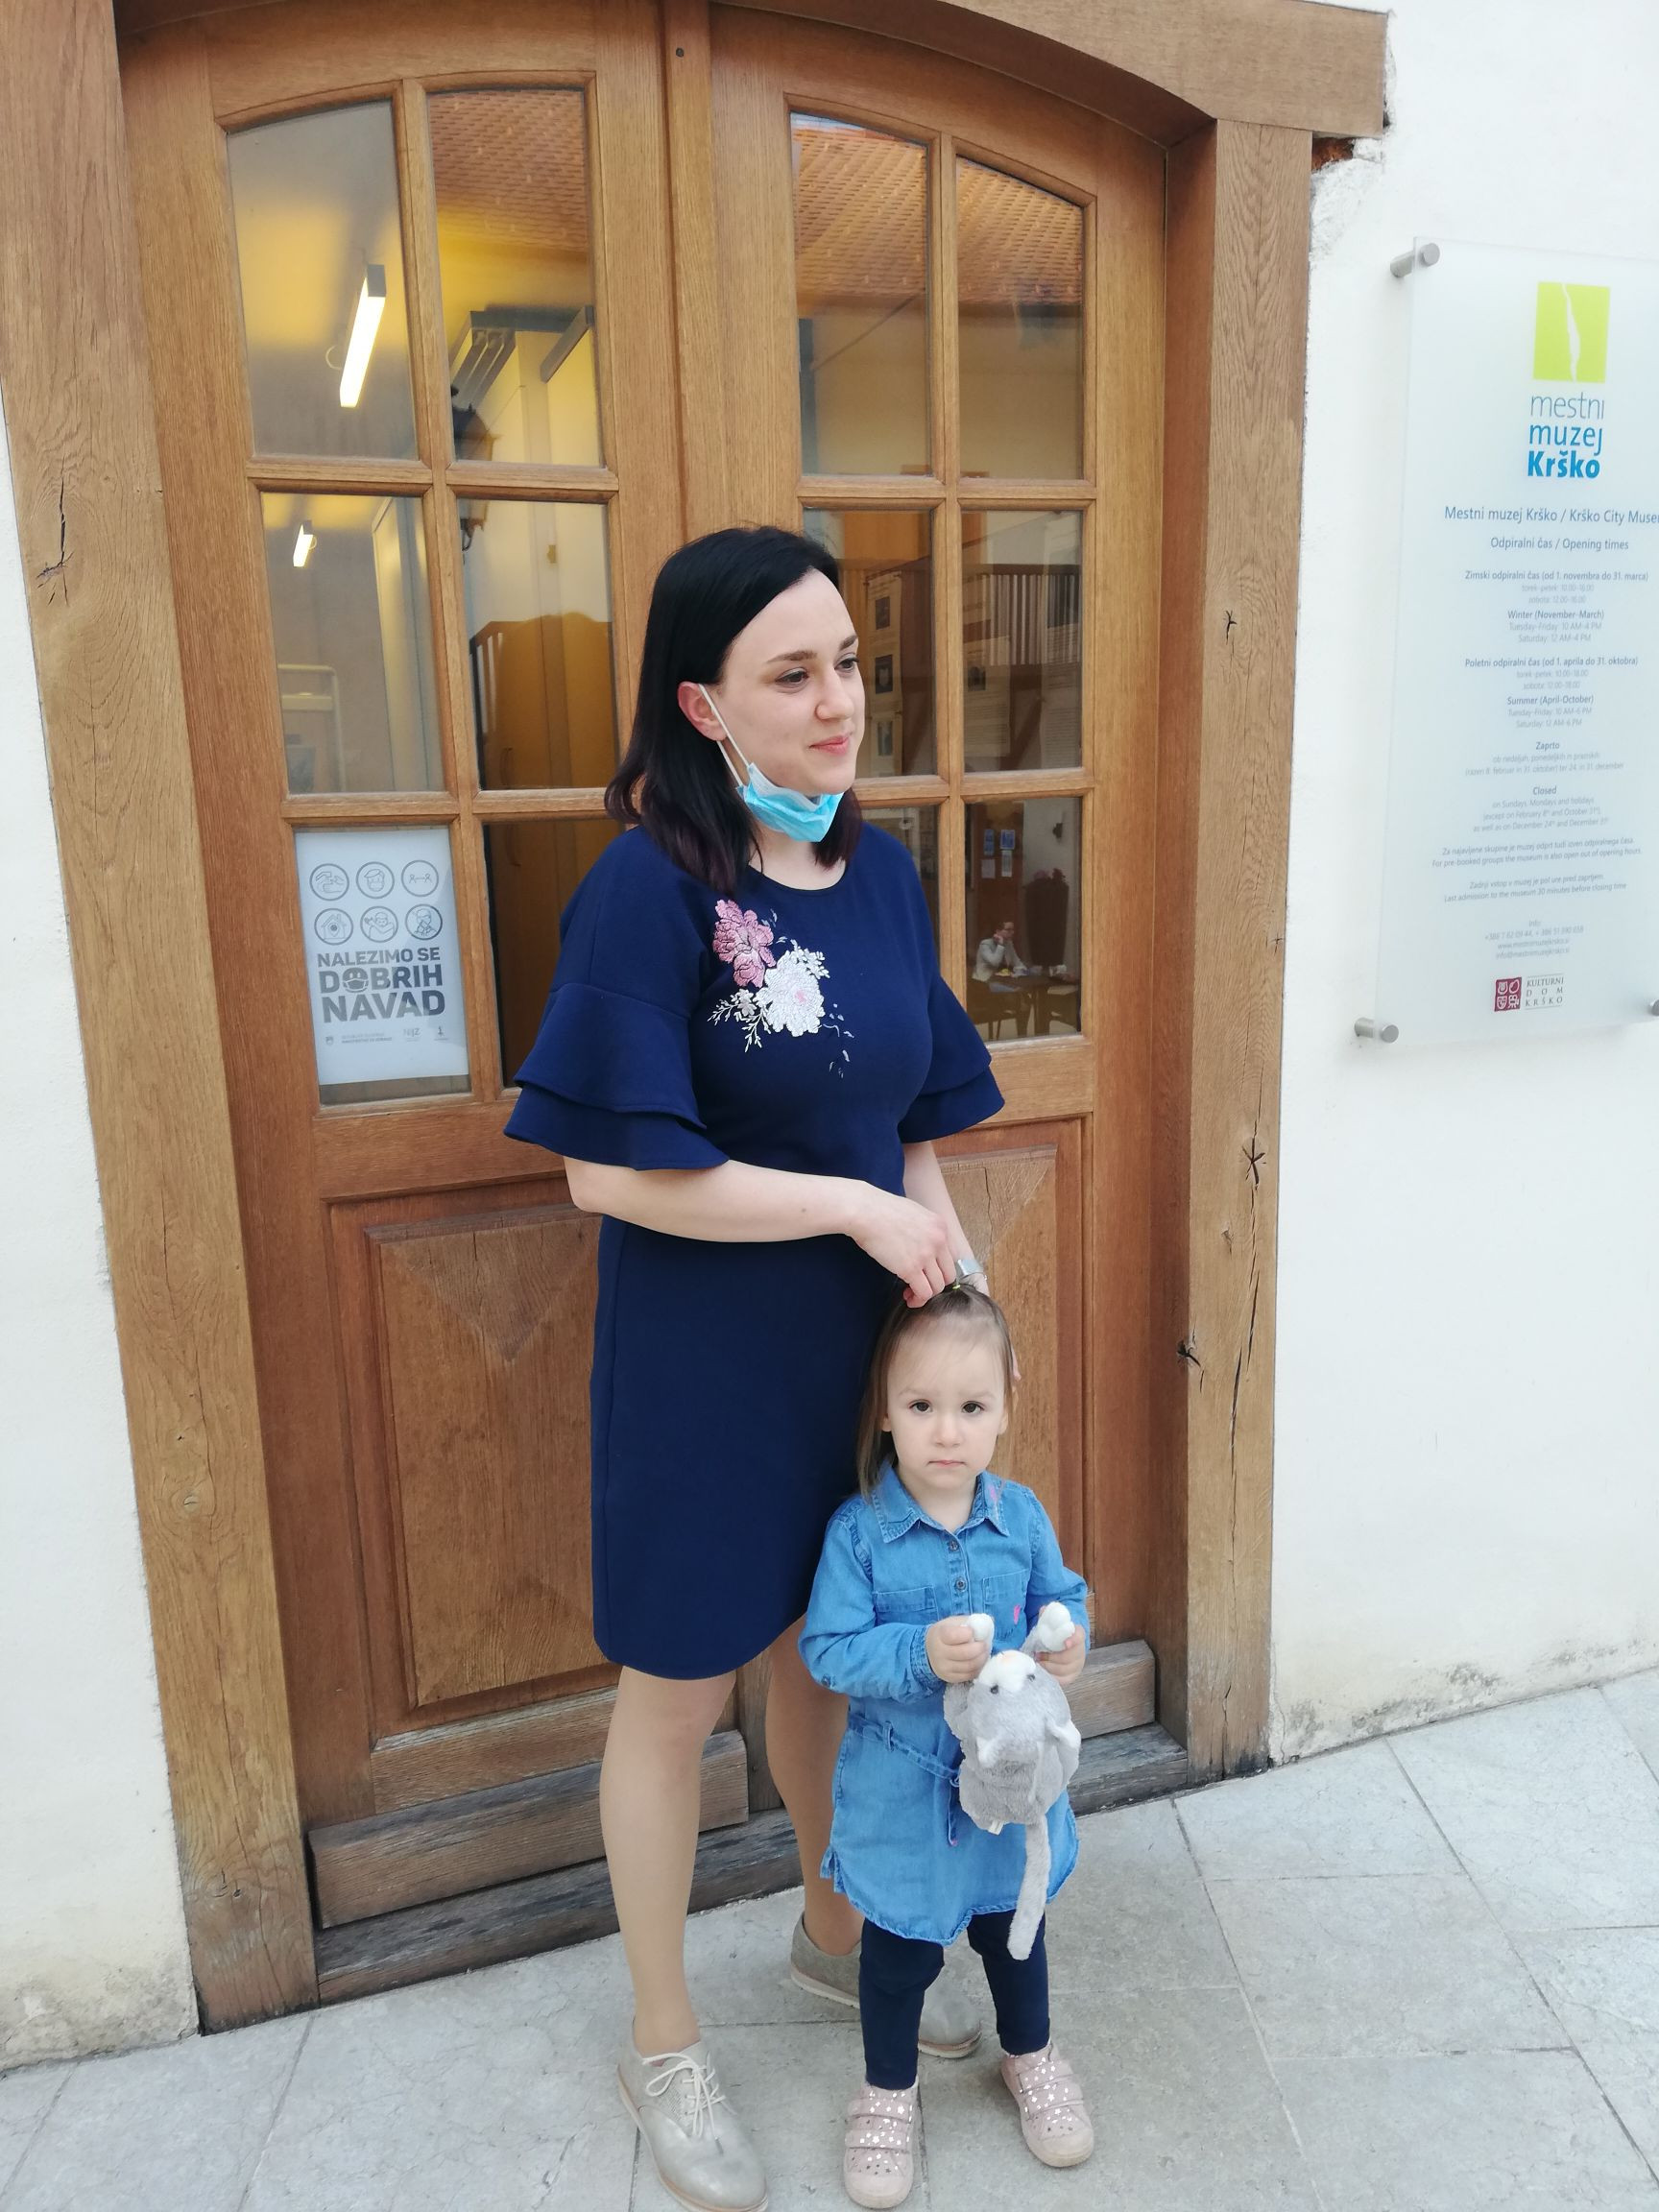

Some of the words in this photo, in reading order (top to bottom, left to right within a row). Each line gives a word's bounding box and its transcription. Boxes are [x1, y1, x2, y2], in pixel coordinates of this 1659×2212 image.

[1529, 392, 1605, 420] mestni
[1528, 423, 1602, 456] muzej
[1527, 450, 1600, 479] Krško
[1444, 506, 1484, 519] Mestni
[1488, 508, 1523, 524] muzej
[1527, 508, 1557, 521] Krško
[1570, 509, 1600, 522] Krško
[1603, 510, 1624, 526] City
[1490, 537, 1534, 550] Odpiralni
[1537, 537, 1552, 548] čas
[1562, 538, 1601, 552] Opening
[1604, 539, 1629, 549] times
[1465, 570, 1490, 580] Zimski
[1492, 570, 1526, 581] odpiralni
[1542, 570, 1554, 581] (od
[1563, 571, 1599, 580] novembra
[1601, 571, 1612, 580] do
[1465, 658, 1491, 667] Poletni
[1493, 657, 1526, 668] odpiralni
[1542, 657, 1554, 667] (od
[1563, 657, 1583, 667] aprila
[1585, 657, 1595, 665] do
[1608, 657, 1638, 666] oktobra)
[1535, 741, 1560, 752] Zaprto
[1532, 785, 1557, 796] Closed
[317, 949, 413, 968] NALEZIMO
[417, 947, 441, 961] SE
[1527, 976, 1564, 988] KULTURNI
[322, 989, 445, 1022] NAVAD
